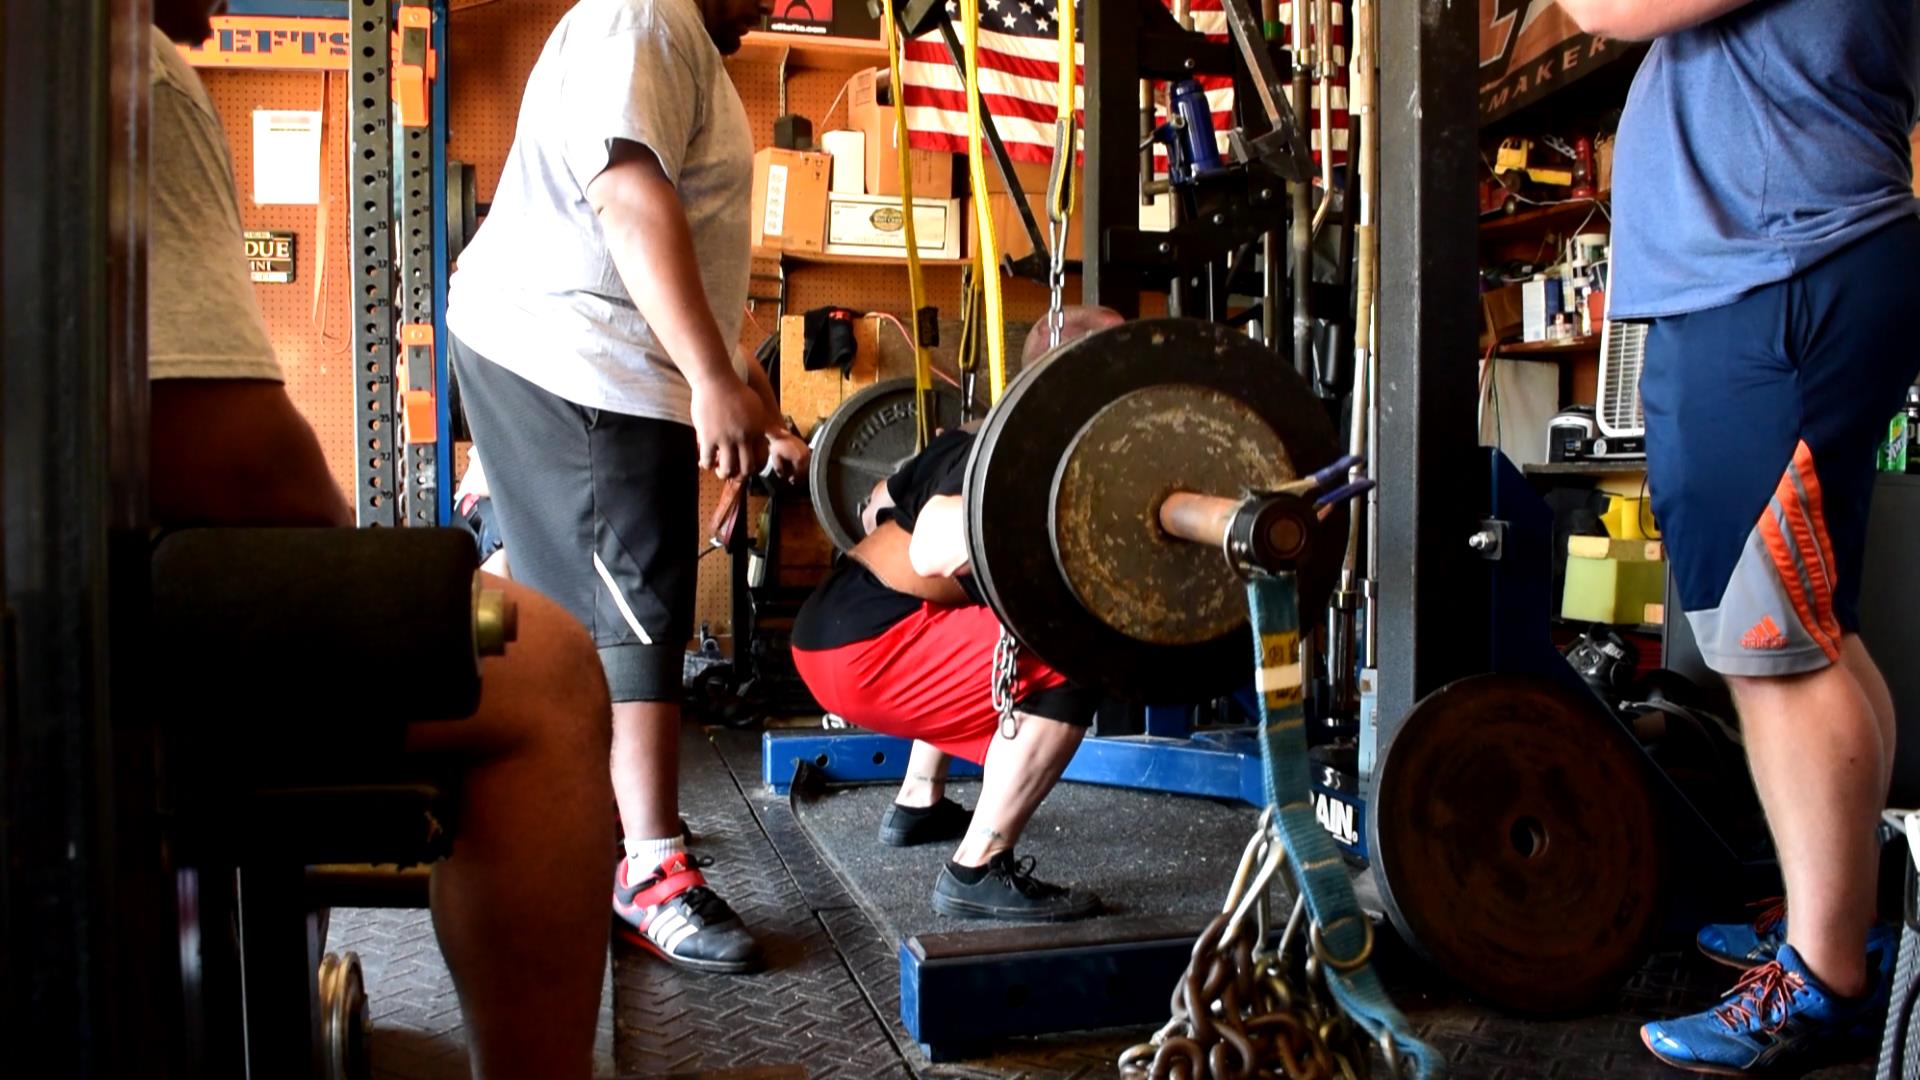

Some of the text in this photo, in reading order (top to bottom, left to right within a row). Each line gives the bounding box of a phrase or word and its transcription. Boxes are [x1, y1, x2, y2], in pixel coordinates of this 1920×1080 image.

[208, 28, 350, 55] EFTS
[1487, 35, 1607, 113] MAKER
[245, 241, 290, 258] DUE
[1309, 789, 1358, 842] AIN.
